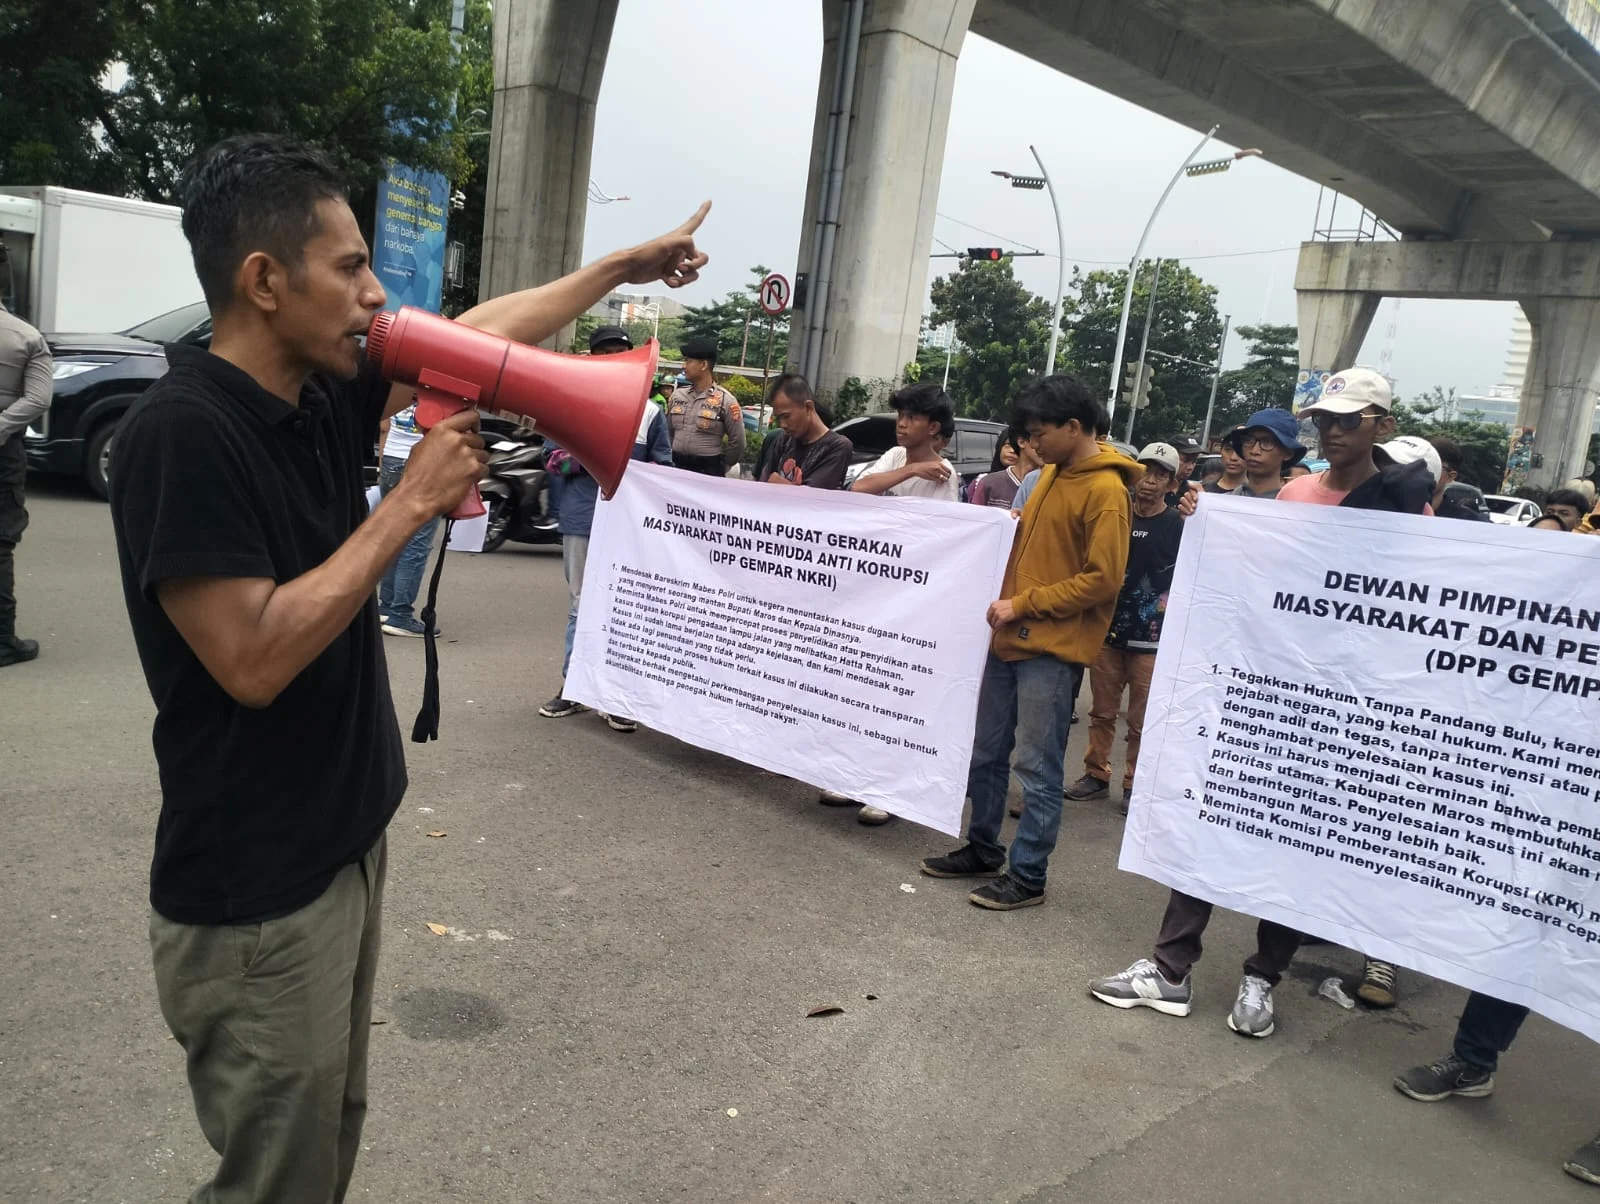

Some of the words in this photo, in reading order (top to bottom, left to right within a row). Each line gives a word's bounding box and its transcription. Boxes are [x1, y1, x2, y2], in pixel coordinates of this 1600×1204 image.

[385, 222, 400, 233] dari
[400, 225, 425, 242] bahaya
[643, 516, 723, 544] MASYARAKAT
[726, 533, 752, 551] DAN
[756, 539, 813, 563] PEMUDA
[816, 552, 853, 571] ANTI
[856, 559, 929, 586] KORUPSI
[666, 502, 706, 522] DEWAN
[709, 511, 772, 535] PIMPINAN
[776, 524, 823, 544] PUSAT
[827, 533, 903, 559] GERAKAN
[709, 549, 736, 566] (DPP
[739, 556, 793, 580] GEMPAR
[796, 568, 837, 592] NKRI)
[1324, 570, 1430, 604] DEWAN
[1438, 587, 1600, 635] PIMPINAN
[753, 608, 776, 622] Maros
[777, 615, 793, 626] dan
[793, 618, 821, 633] Kepala
[822, 626, 862, 644] Dinasnya.
[758, 600, 785, 612] segera
[786, 607, 840, 625] menuntaskan
[841, 618, 866, 632] kasus
[867, 625, 899, 640] dugaan
[901, 633, 937, 650] korupsi
[761, 624, 788, 637] proses
[788, 631, 838, 650] penyelidikan
[839, 645, 859, 656] atau
[860, 650, 909, 669] penyidikan
[911, 664, 934, 675] atas
[1272, 591, 1470, 642] MASYARAKAT
[1477, 625, 1546, 656] DAN
[752, 632, 773, 645] jalan
[773, 639, 793, 652] yang
[793, 645, 838, 663] melibatkan
[839, 655, 863, 670] Hatta
[865, 662, 904, 681] Rahman.
[765, 648, 804, 667] kejelasan,
[806, 659, 822, 671] dan
[823, 663, 844, 677] kami
[845, 672, 890, 691] mendesak
[892, 685, 915, 697] agar
[1425, 648, 1497, 678] (DPP
[1507, 664, 1600, 698] GEMP
[762, 671, 786, 685] kasus
[787, 678, 798, 689] ini
[798, 682, 839, 701] dilakukan
[840, 696, 870, 711] secara
[872, 704, 925, 727] transparan
[766, 698, 820, 721] penyelesaian
[821, 713, 846, 729] kasus
[848, 722, 862, 736] ini,
[864, 729, 901, 746] sebagai
[903, 738, 938, 757] bentuk
[770, 711, 799, 726] rakyat.
[1211, 663, 1223, 675] 1.
[1230, 667, 1299, 692] Tegakkan
[1303, 683, 1358, 706] Hukum
[1364, 695, 1414, 718] Tanpa
[1419, 708, 1497, 738] Pandang
[1502, 725, 1547, 749] Bulu,
[1225, 685, 1280, 705] pejabat
[1283, 698, 1341, 722] negara,
[1345, 712, 1385, 732] yang
[1390, 719, 1437, 741] kebal
[1441, 731, 1507, 757] hukum.
[1511, 747, 1561, 769] Kami
[1197, 725, 1209, 738] 2.
[1216, 730, 1260, 751] Kasus
[1264, 742, 1283, 757] ini
[1286, 748, 1329, 769] harus
[1334, 762, 1401, 787] menjadi
[1405, 781, 1488, 809] cerminan
[1493, 799, 1552, 827] bahwa
[1220, 717, 1314, 748] menghambat
[1317, 741, 1427, 776] penyelesaian
[1432, 766, 1485, 789] kasus
[1490, 779, 1515, 798] ini.
[1223, 699, 1275, 721] dengan
[1279, 714, 1307, 729] adil
[1310, 720, 1339, 736] dan
[1344, 727, 1395, 752] tegas,
[1401, 741, 1450, 762] tanpa
[1455, 752, 1545, 785] intervensi
[1550, 778, 1590, 797] atau
[1211, 748, 1273, 772] prioritas
[1277, 765, 1329, 787] utama.
[1334, 778, 1426, 812] Kabupaten
[1431, 802, 1485, 827] Maros
[1205, 780, 1295, 812] membangun
[1299, 803, 1348, 826] Maros
[1351, 820, 1392, 842] yang
[1397, 830, 1439, 852] lebih
[1444, 842, 1485, 866] baik.
[1208, 763, 1234, 779] dan
[1238, 770, 1342, 808] berintegritas.
[1347, 798, 1460, 839] Penyelesaian
[1465, 829, 1515, 856] kasus
[1520, 846, 1544, 864] ini
[1548, 857, 1590, 878] akan
[1183, 788, 1195, 801] 3.
[1202, 793, 1265, 821] Meminta
[1269, 812, 1322, 837] Komisi
[1326, 828, 1457, 876] Pemberantasan
[1462, 867, 1530, 899] Korupsi
[1534, 890, 1584, 920] (KPK)
[1198, 809, 1232, 828] Polri
[1235, 820, 1274, 841] tidak
[1278, 834, 1335, 858] mampu
[1339, 852, 1496, 908] menyelesaikannya
[1501, 901, 1562, 928] secara
